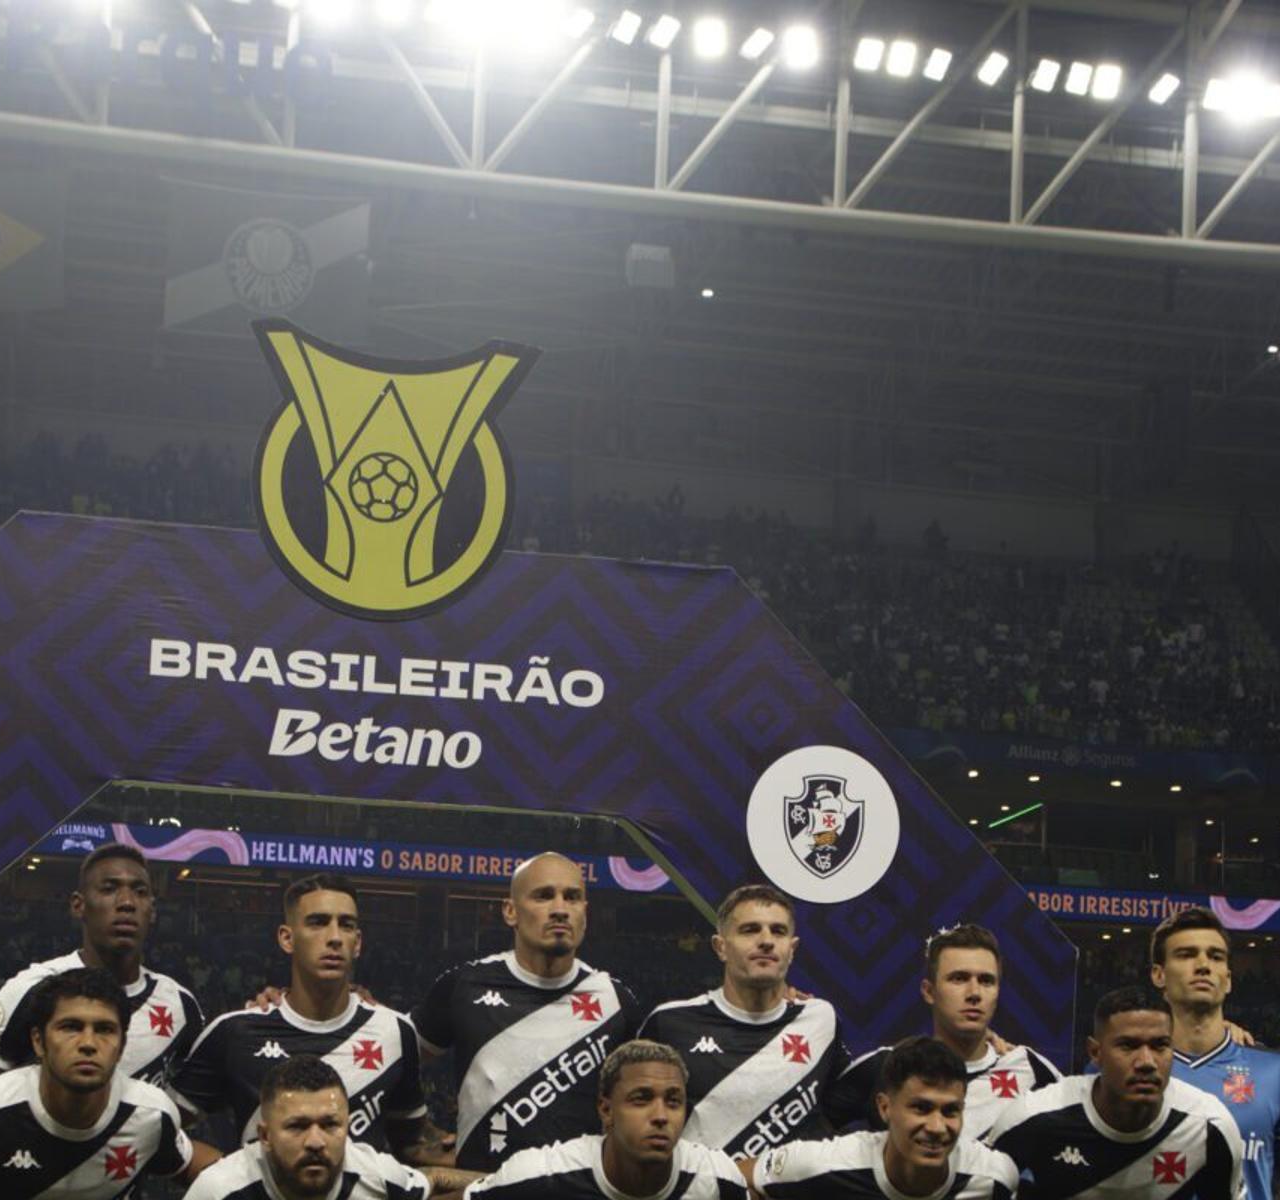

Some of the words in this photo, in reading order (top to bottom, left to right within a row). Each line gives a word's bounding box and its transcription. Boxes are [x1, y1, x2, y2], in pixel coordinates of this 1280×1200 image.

[228, 252, 312, 309] PALMEIRAS
[148, 637, 605, 708] BRASILEIRÃO
[268, 708, 482, 770] Betano
[1007, 744, 1061, 763] Allianz
[1082, 750, 1137, 769] Seguros
[251, 841, 375, 869] HELLMANN'S
[381, 850, 393, 869] O
[399, 852, 463, 874] SABOR
[502, 1033, 610, 1129] betfair
